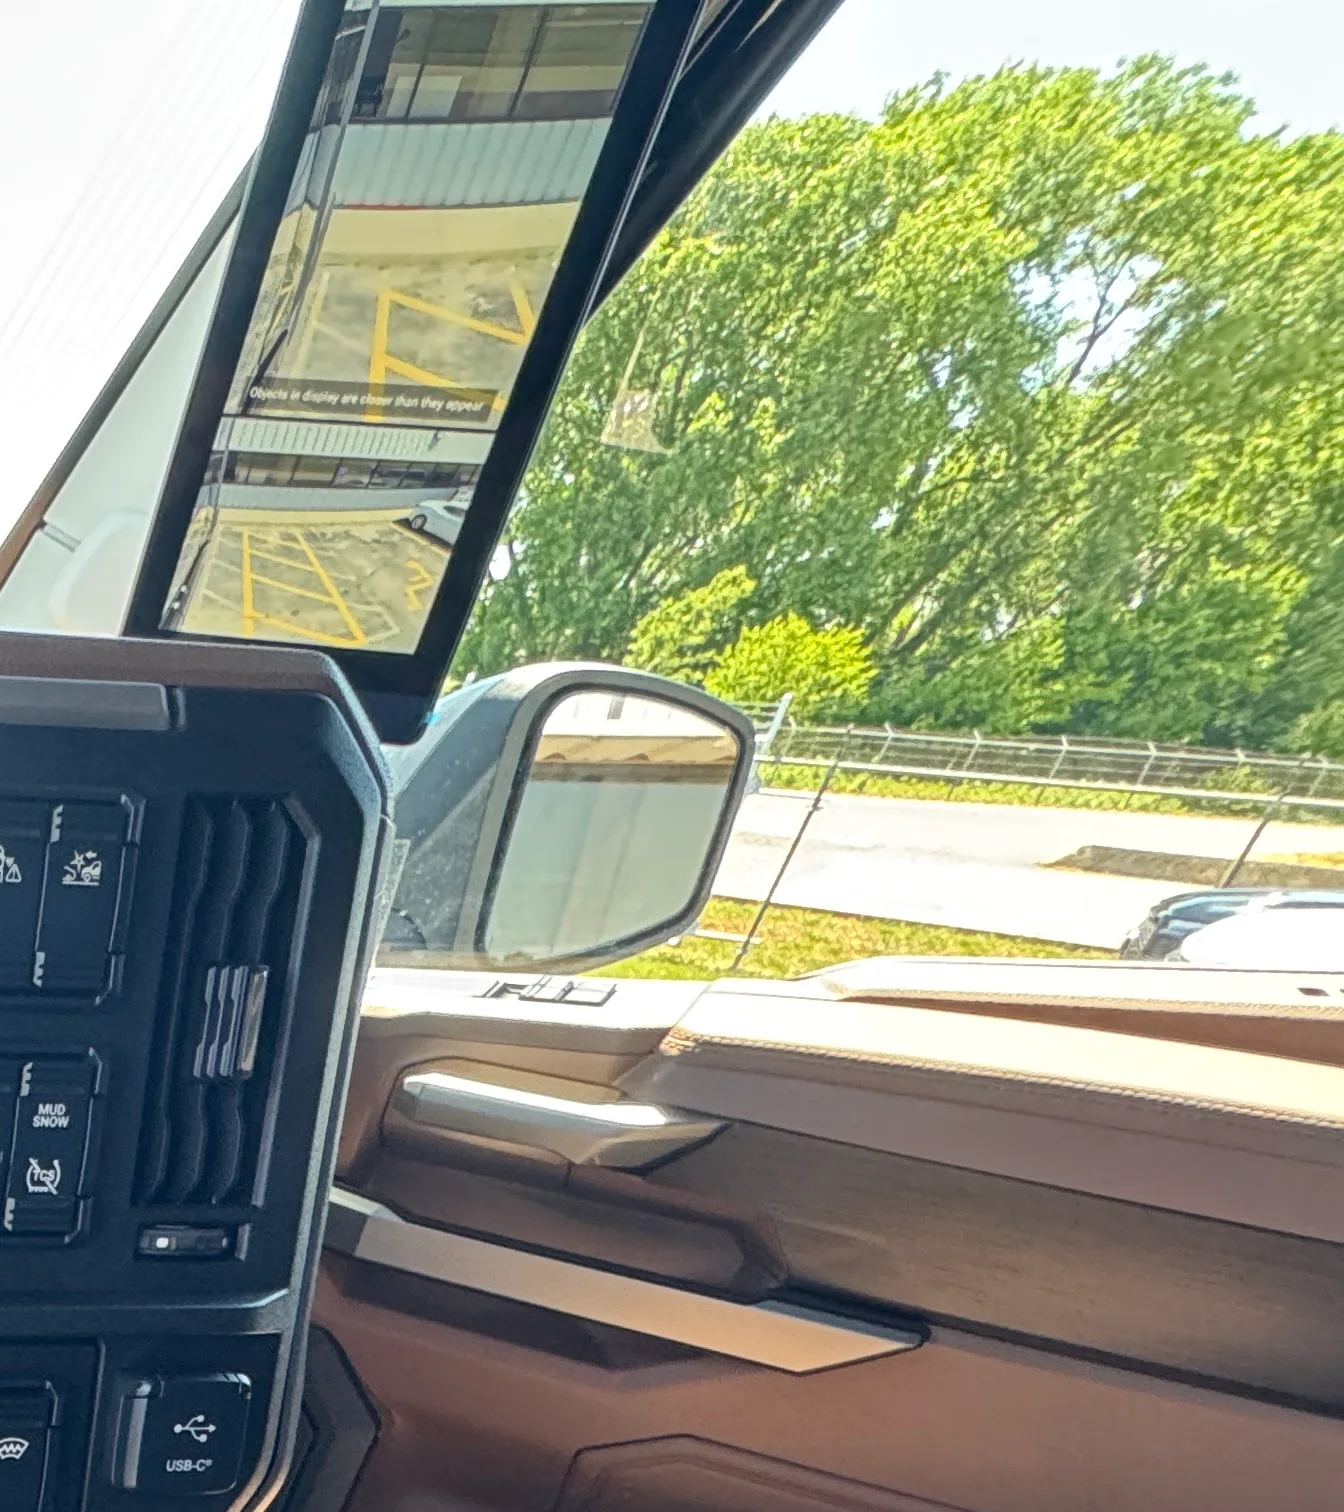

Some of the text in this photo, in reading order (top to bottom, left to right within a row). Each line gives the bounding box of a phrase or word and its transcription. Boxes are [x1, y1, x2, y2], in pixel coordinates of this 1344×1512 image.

[250, 387, 486, 413] Objects in display are closer than they appear
[38, 1103, 66, 1116] MUD
[32, 1115, 70, 1128] SNOW
